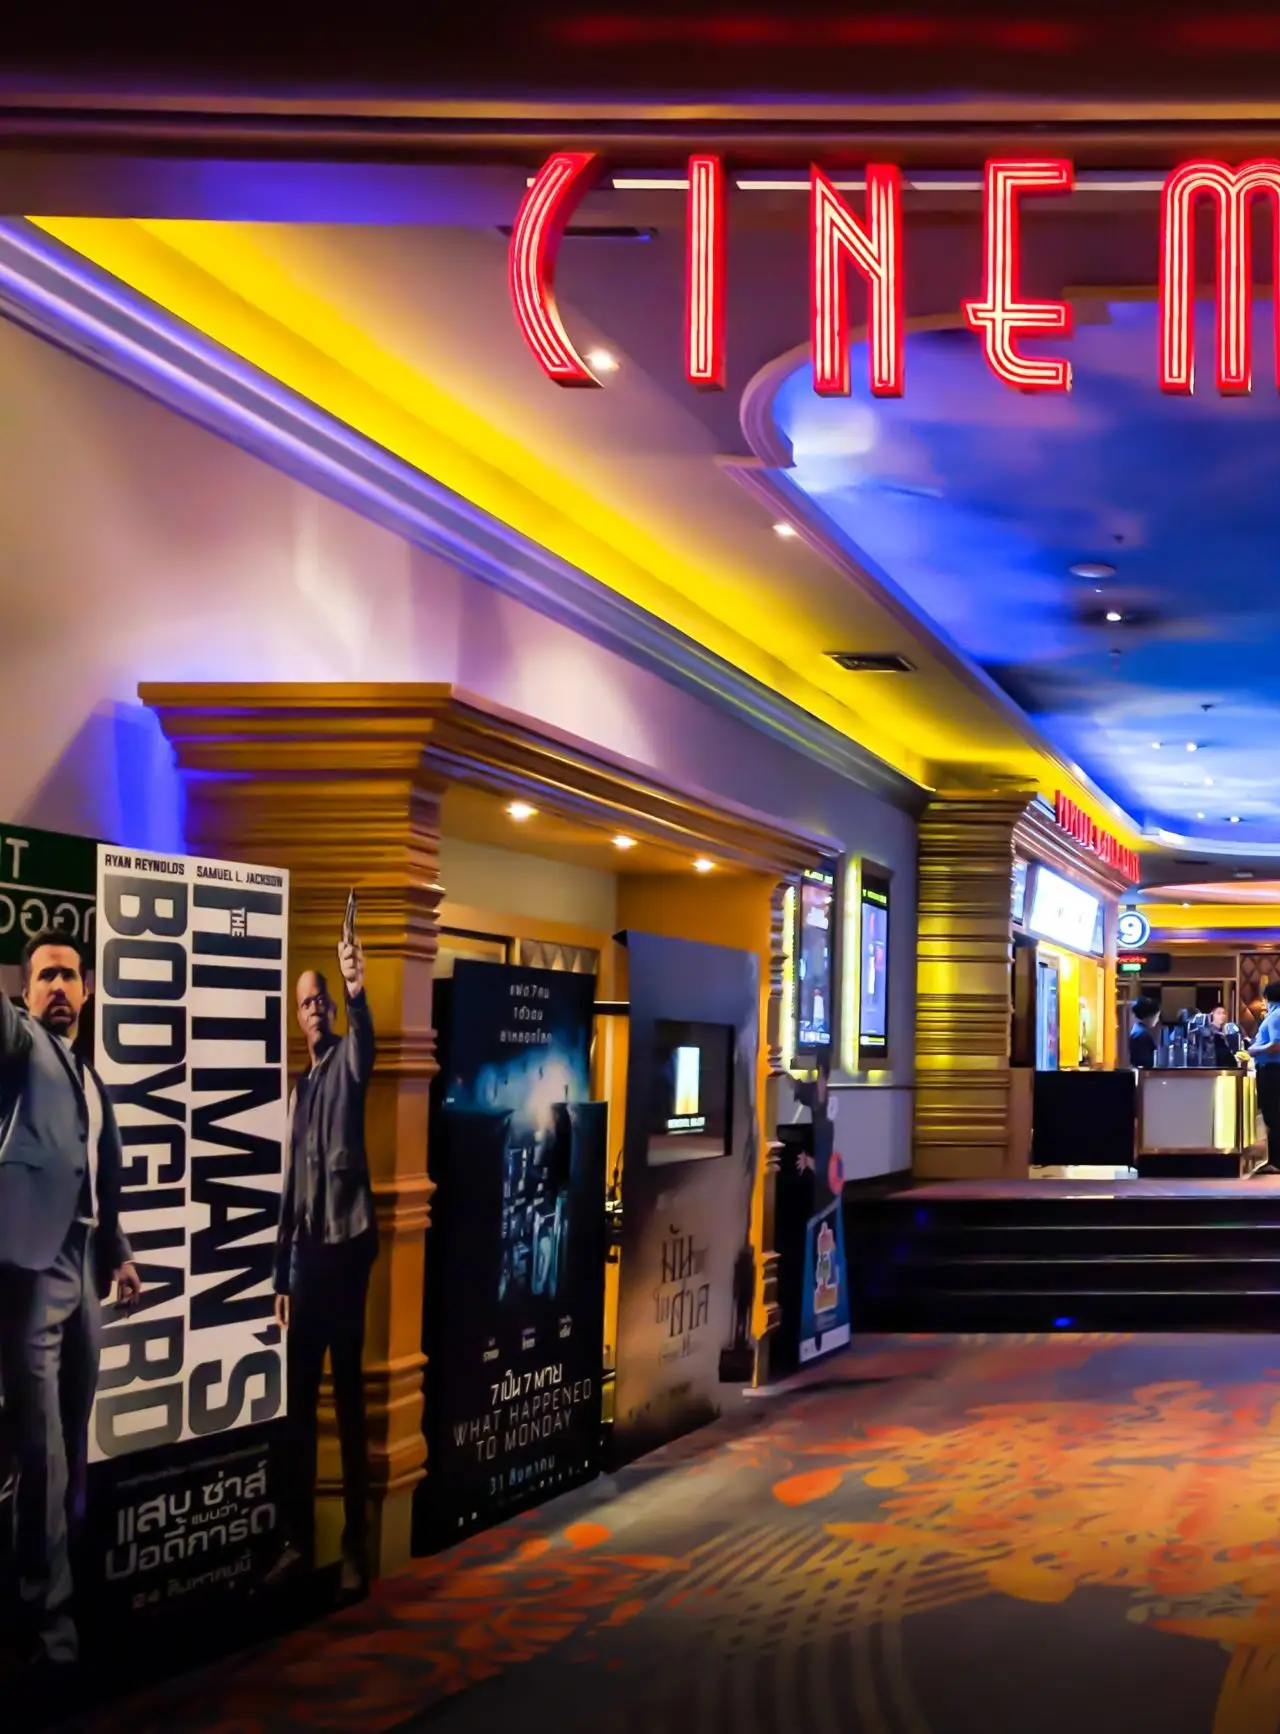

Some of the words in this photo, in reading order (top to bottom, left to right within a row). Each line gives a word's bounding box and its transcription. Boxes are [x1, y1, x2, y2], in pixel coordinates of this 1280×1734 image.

[0, 836, 29, 879] T
[105, 854, 131, 869] RYAN
[135, 857, 185, 876] REYNOLDS
[197, 865, 232, 882] SAMUEL
[236, 870, 243, 884] L.
[245, 871, 283, 888] JACKSON
[231, 907, 245, 938] THE
[95, 874, 189, 1458] BODYGUARD
[188, 883, 283, 1436] HITMAN'S
[454, 1410, 502, 1447] WHAT
[510, 1378, 591, 1425] HAPPENED
[476, 1436, 496, 1462] TO
[505, 1408, 572, 1452] MONDAY
